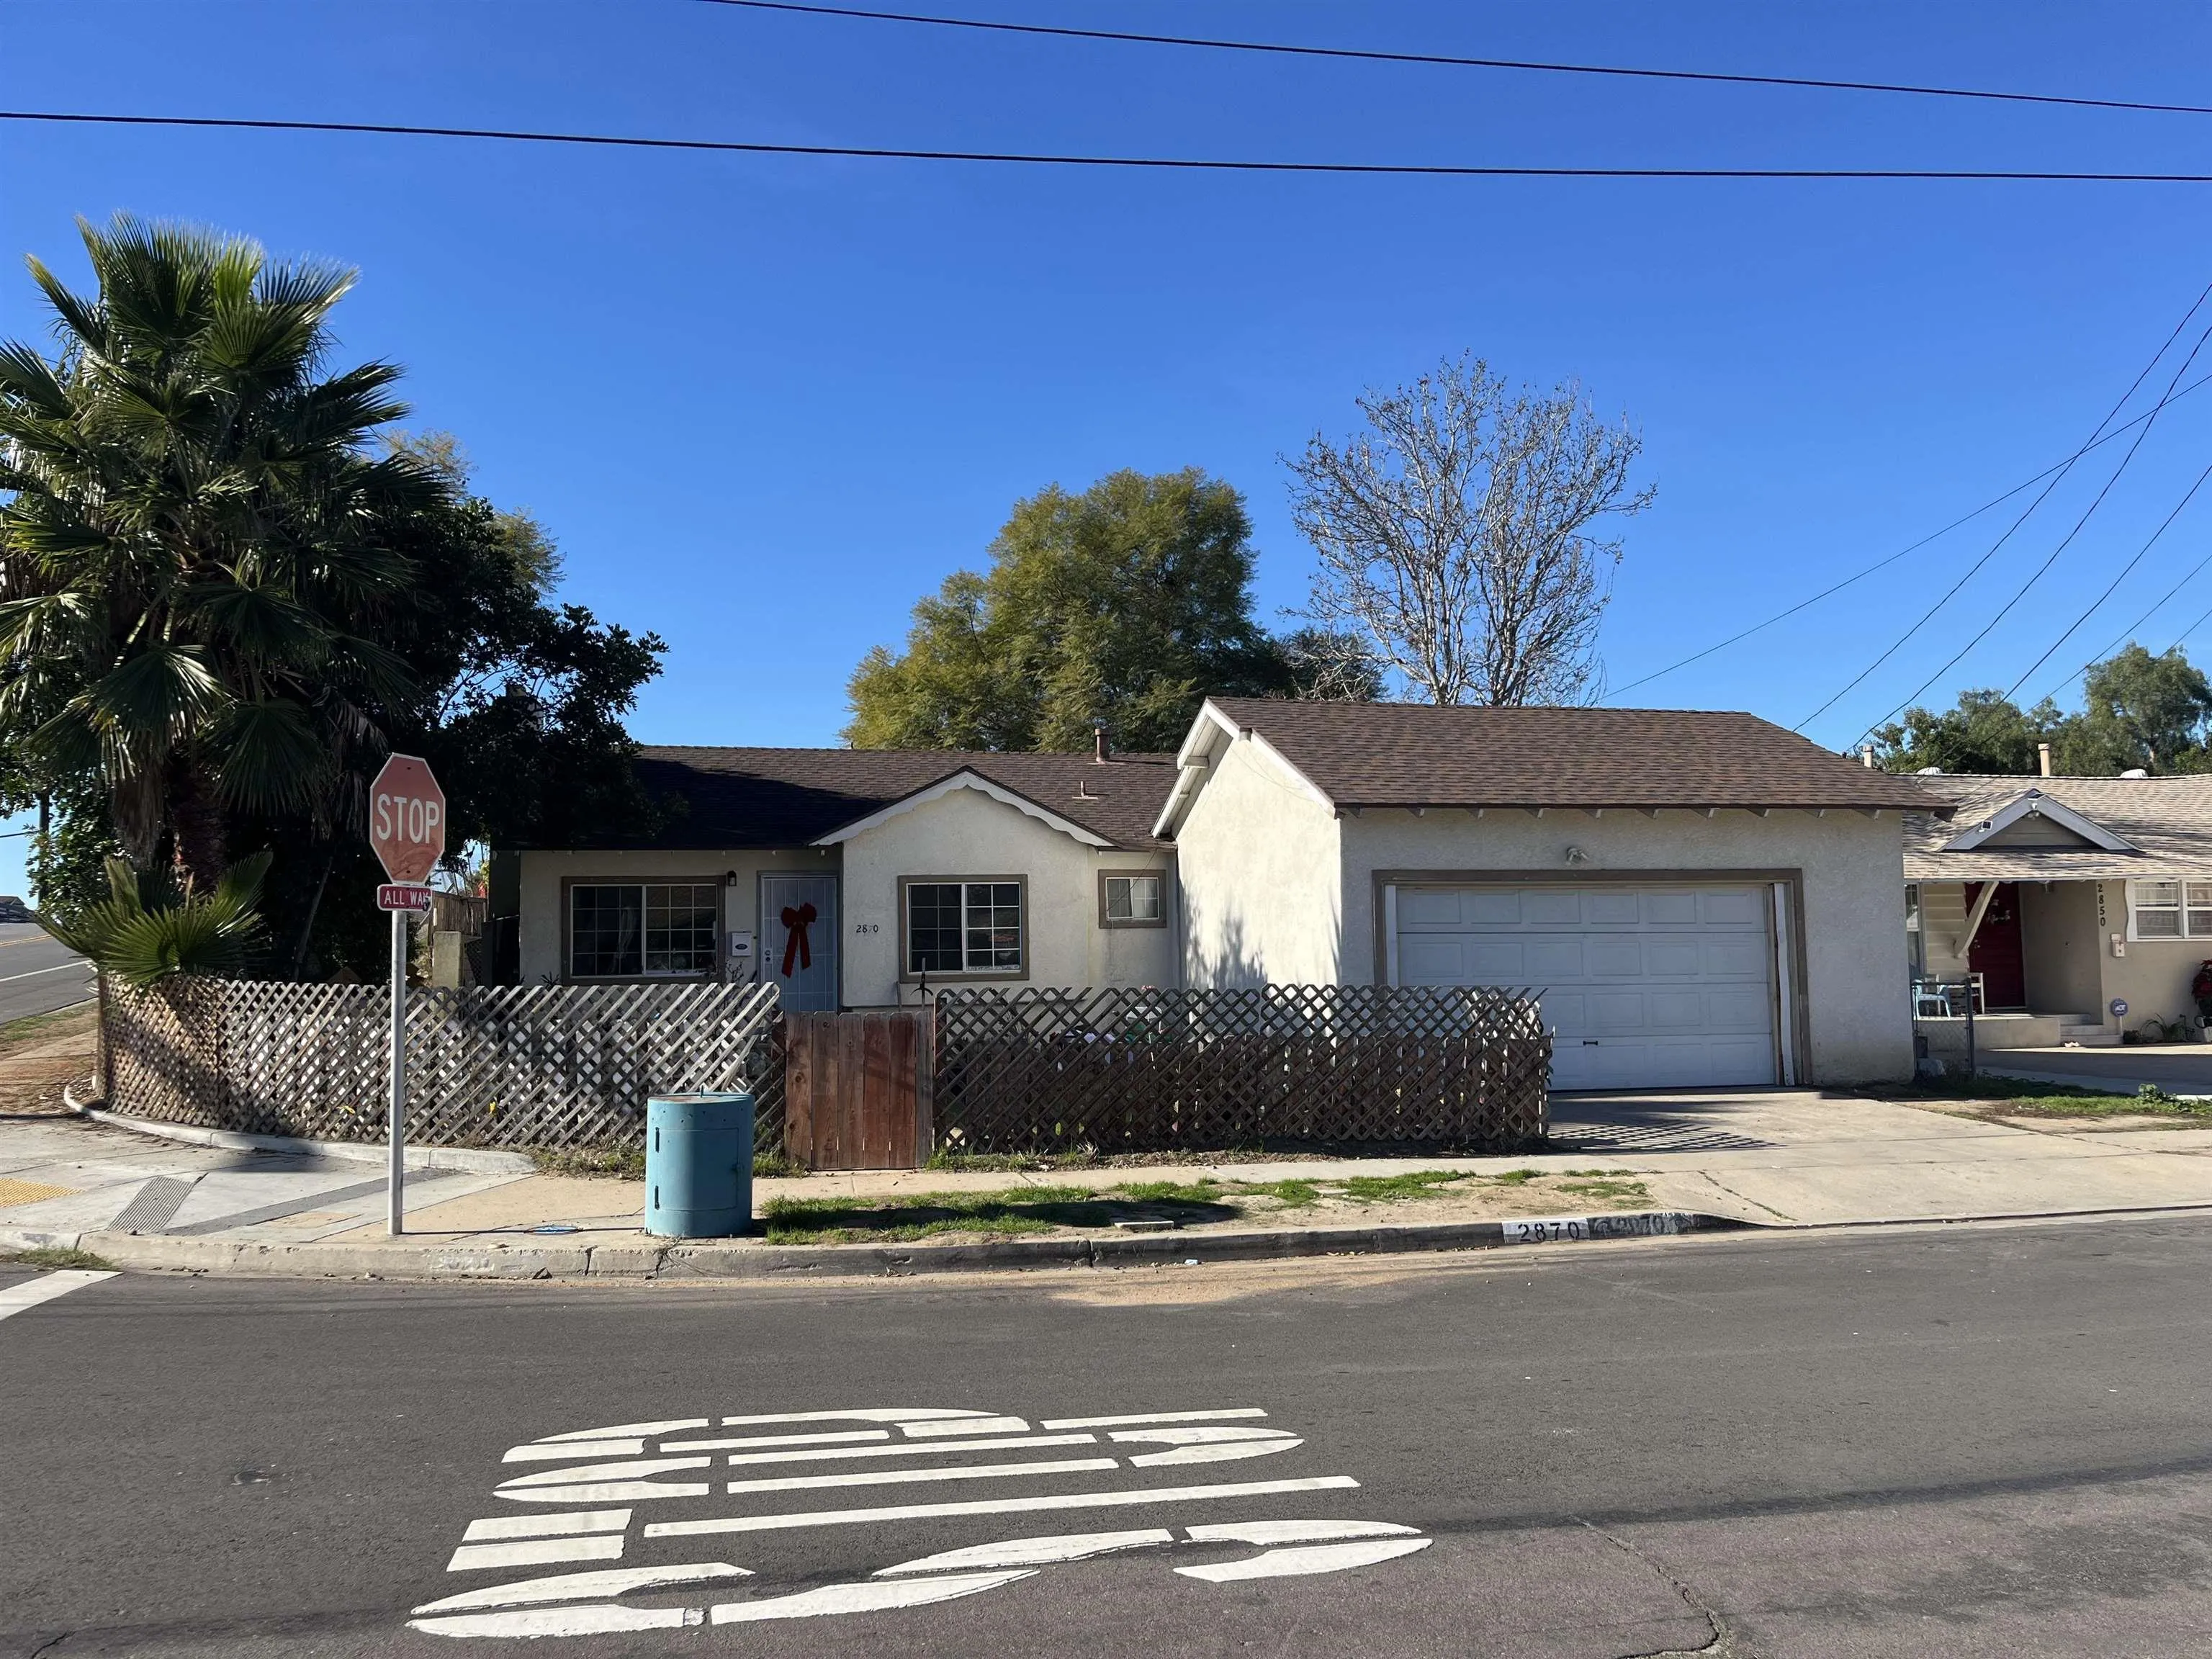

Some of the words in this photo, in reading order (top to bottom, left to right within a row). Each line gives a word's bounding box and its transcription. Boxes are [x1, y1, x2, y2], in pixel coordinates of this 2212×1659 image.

[376, 793, 441, 844] STOP
[384, 890, 405, 905] ALL
[1517, 1222, 1581, 1241] 2870
[404, 1408, 1433, 1640] STOP
